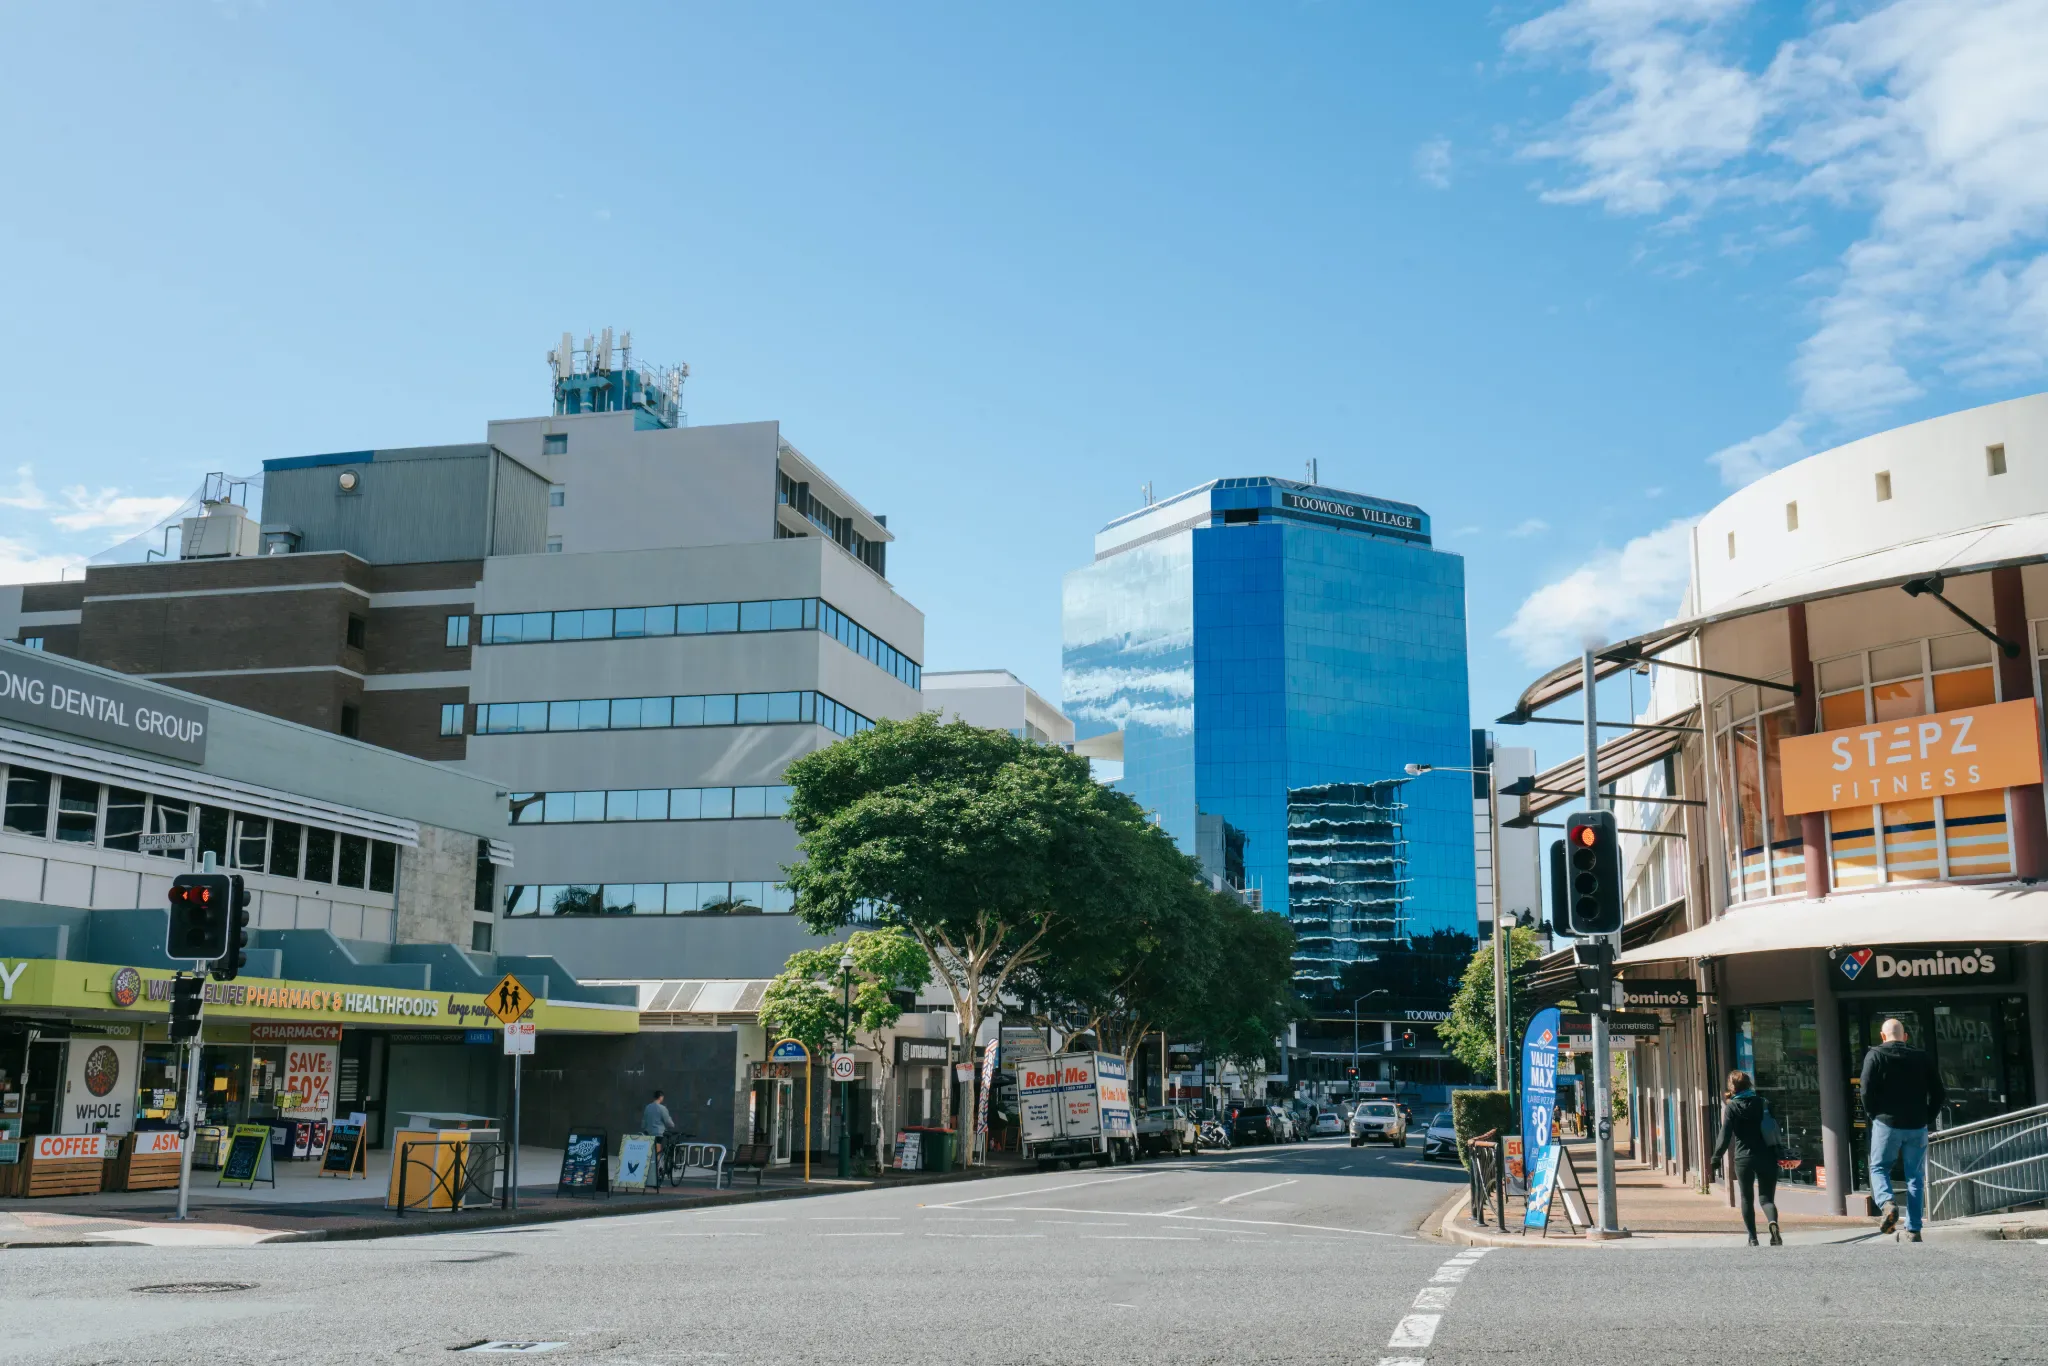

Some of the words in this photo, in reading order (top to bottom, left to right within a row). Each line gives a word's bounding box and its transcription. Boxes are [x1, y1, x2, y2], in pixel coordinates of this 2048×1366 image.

[1290, 494, 1355, 517] TOOWONG
[1362, 508, 1413, 529] VILLAGE
[51, 684, 130, 727] DENTAL
[135, 707, 204, 743] GROUP
[1831, 716, 1977, 772] STEPZ
[1832, 765, 1981, 802] FITNESS
[1875, 948, 1996, 979] Domino's
[246, 985, 331, 1011] PHARMACY
[332, 992, 343, 1012] &
[345, 993, 439, 1017] HEALTHFOODS
[448, 993, 470, 1025] large
[1608, 1022, 1655, 1032] ptometrists
[289, 1052, 327, 1073] SAVE
[836, 1062, 852, 1073] 40
[1531, 1050, 1555, 1068] VALUE
[1025, 1070, 1063, 1088] Rent
[1064, 1067, 1088, 1084] Me
[1531, 1067, 1555, 1089] MAX
[76, 1103, 122, 1119] WHOLE
[40, 1137, 100, 1157] COFFEE
